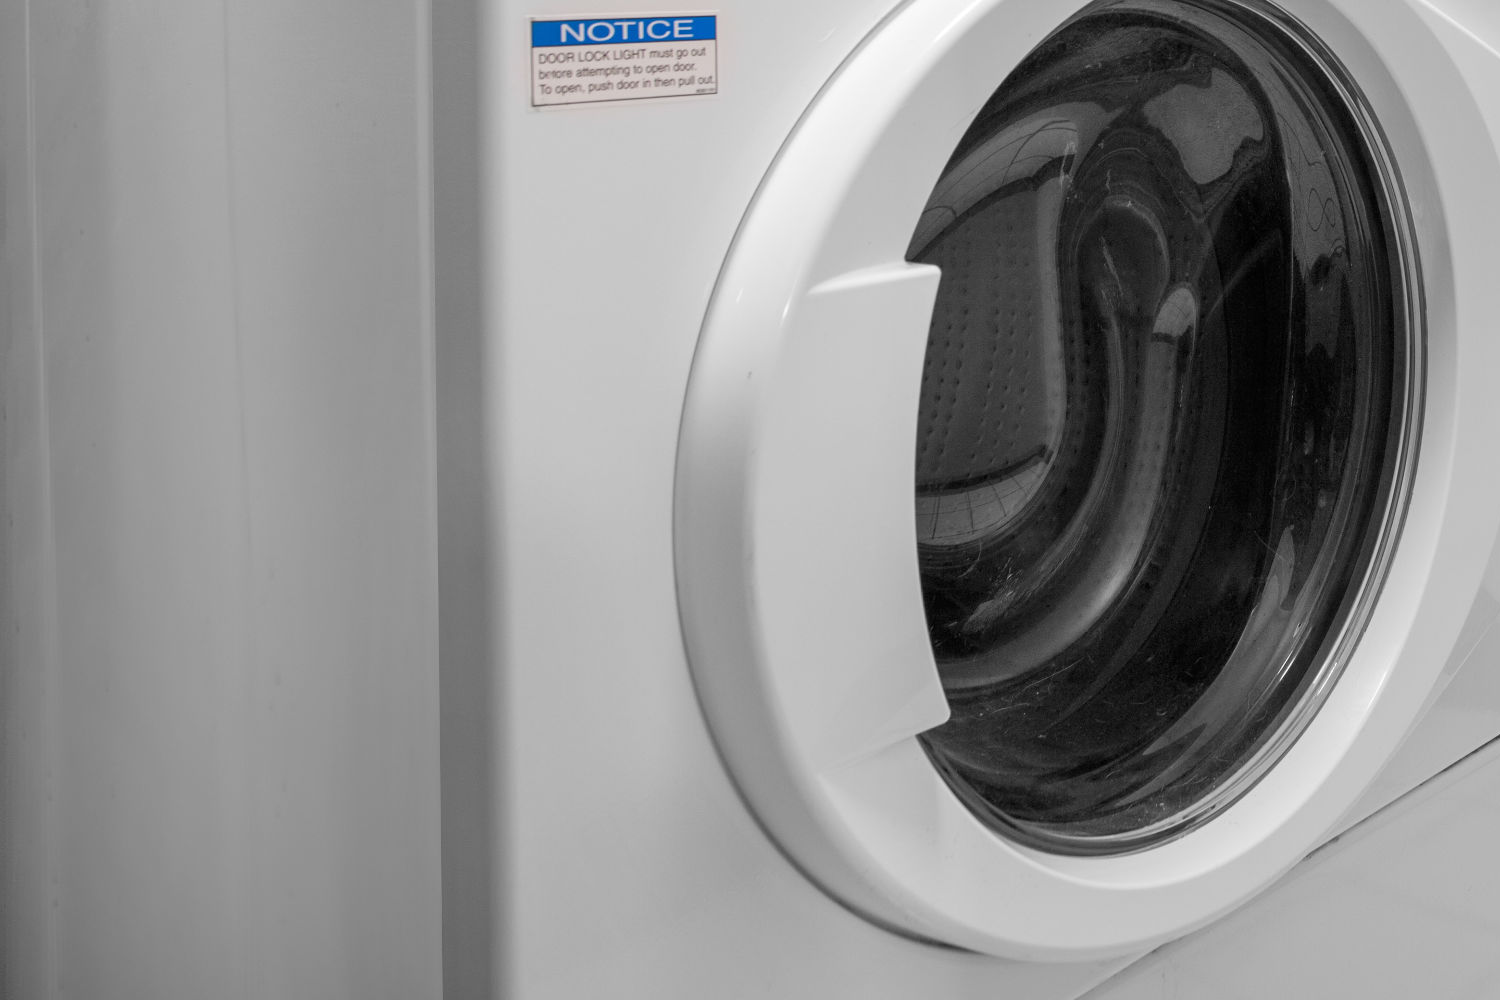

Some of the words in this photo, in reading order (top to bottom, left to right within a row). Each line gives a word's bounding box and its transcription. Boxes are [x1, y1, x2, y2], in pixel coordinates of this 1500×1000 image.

[561, 20, 694, 42] NOTICE
[538, 52, 575, 64] DOOR
[578, 50, 610, 62] LOCK
[613, 48, 646, 60] LIGHT
[649, 47, 674, 58] must
[676, 48, 688, 60] go
[691, 47, 706, 57] out
[576, 66, 630, 78] attempting
[633, 64, 643, 74] to
[645, 64, 670, 75] open
[539, 84, 552, 94] To
[588, 80, 613, 94] push
[617, 80, 640, 90] door
[642, 78, 652, 88] in
[654, 77, 676, 88] then
[679, 76, 695, 88] pull
